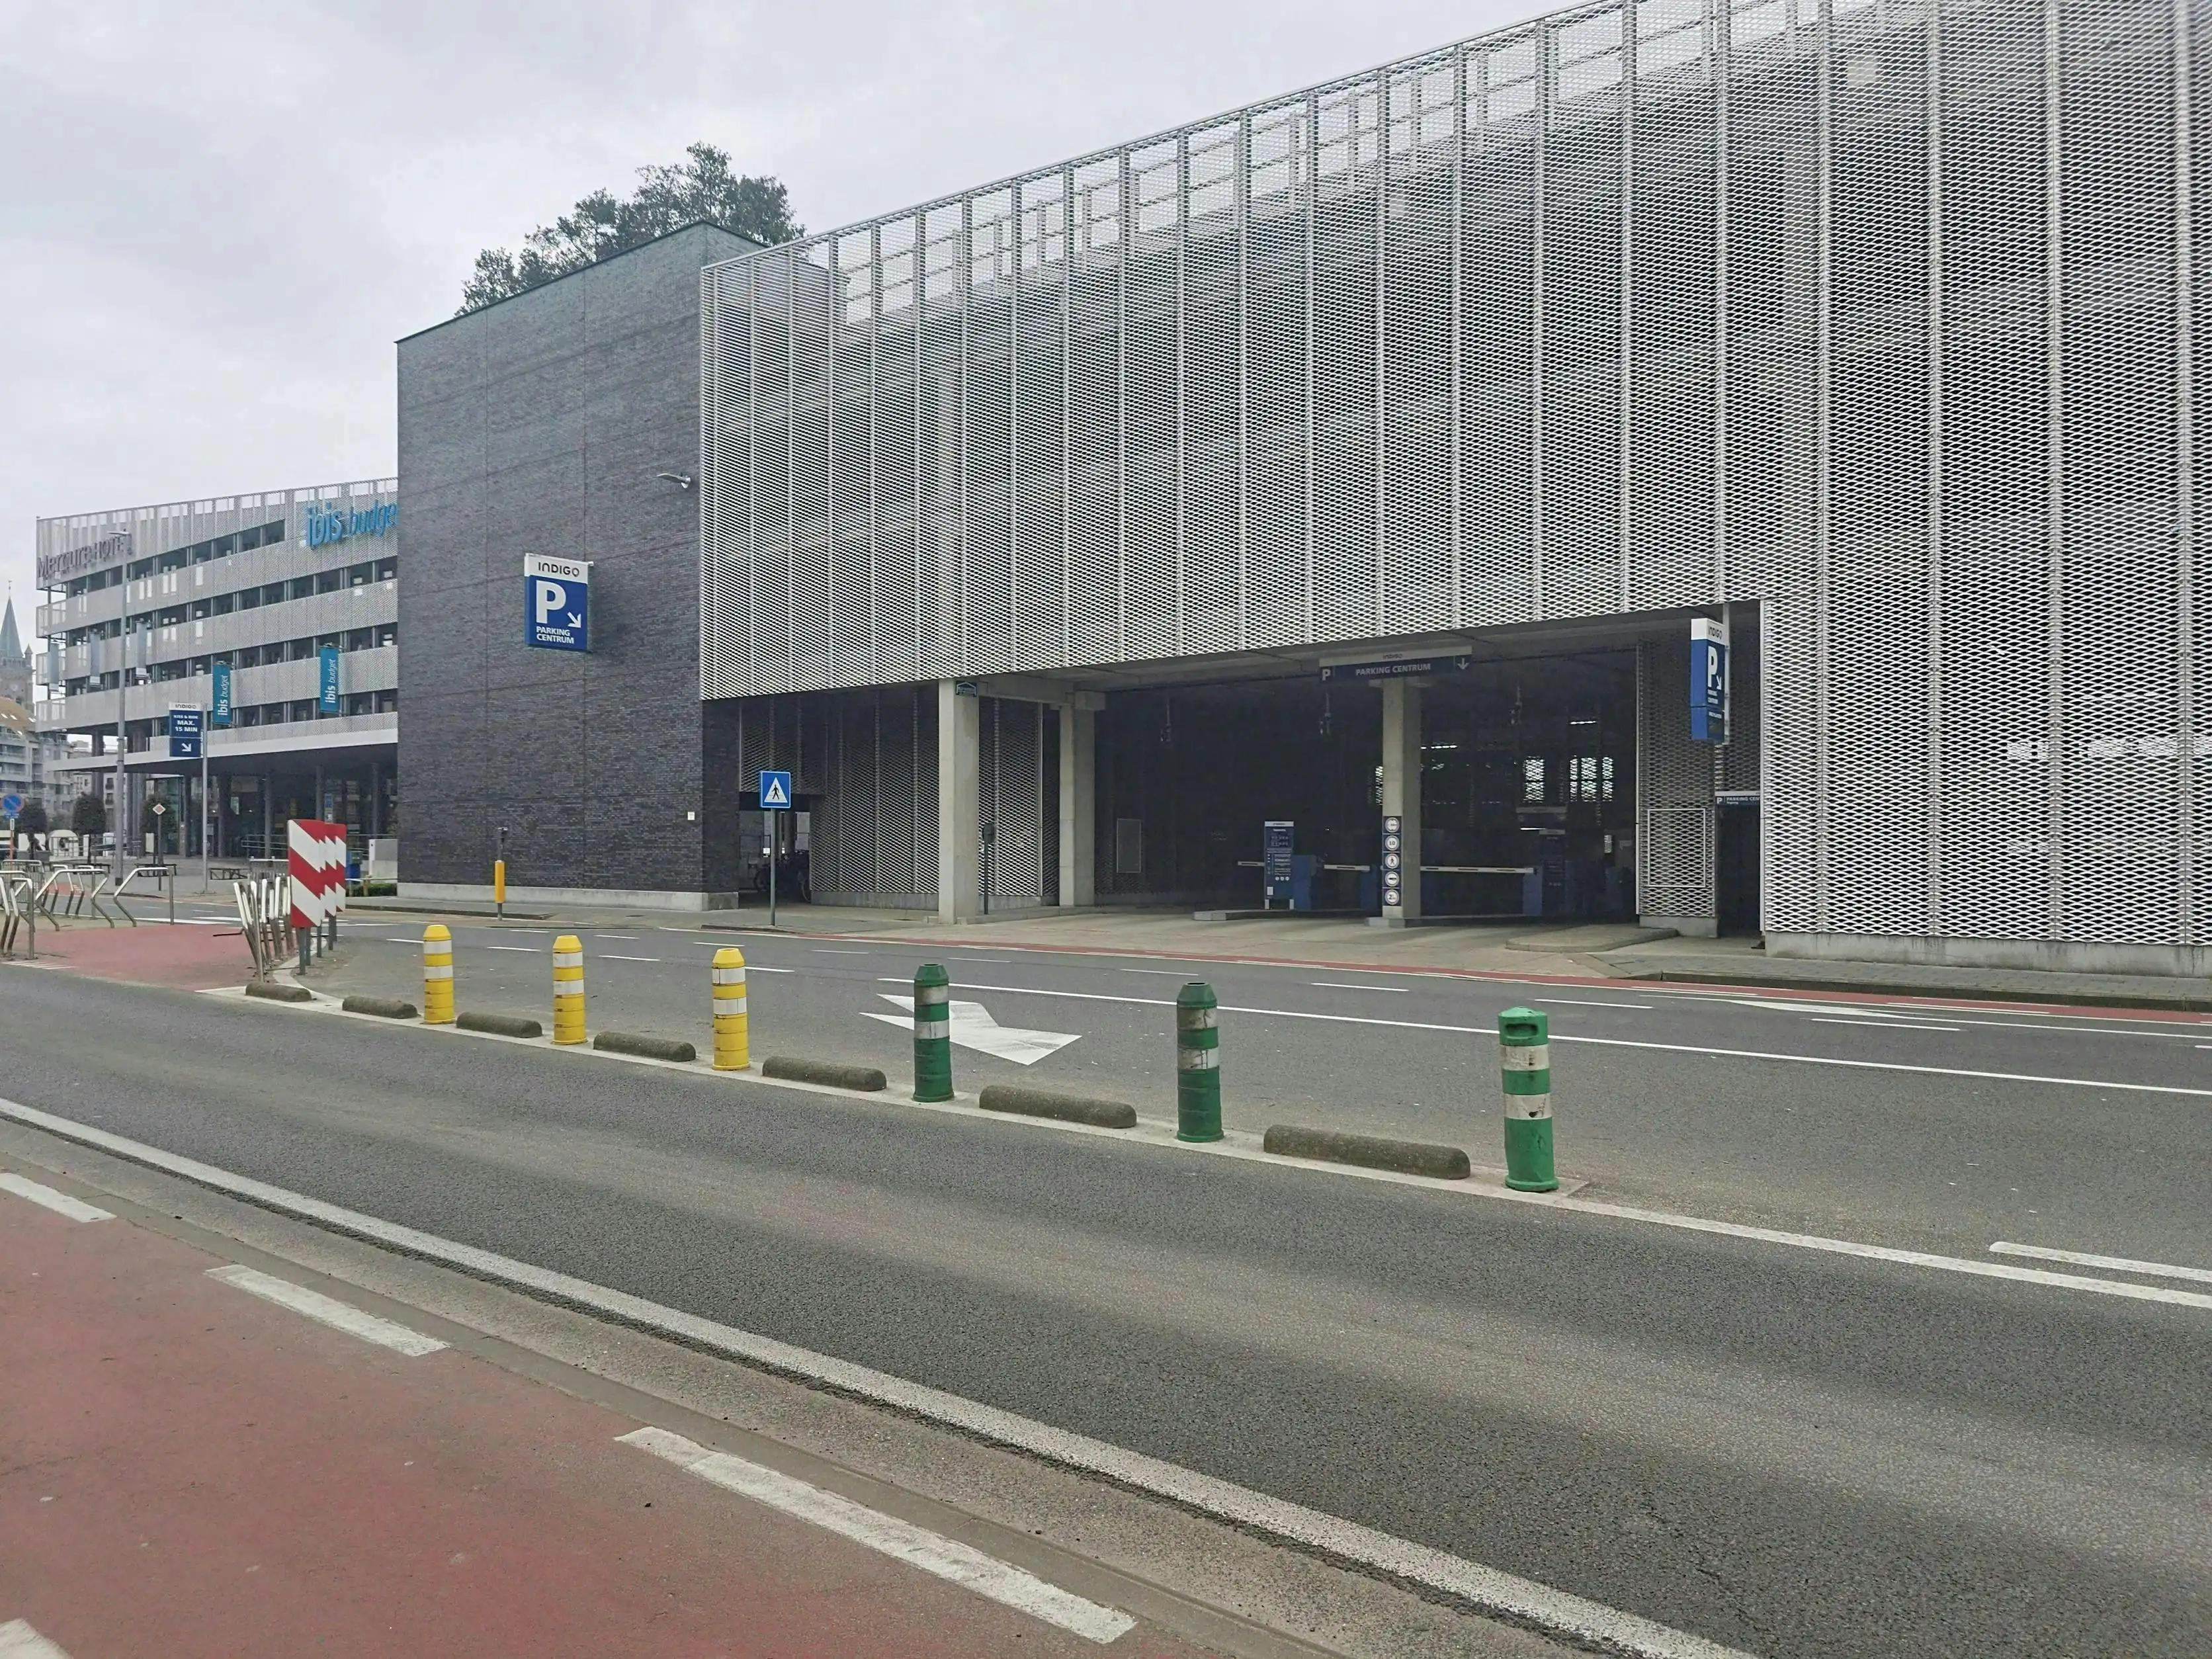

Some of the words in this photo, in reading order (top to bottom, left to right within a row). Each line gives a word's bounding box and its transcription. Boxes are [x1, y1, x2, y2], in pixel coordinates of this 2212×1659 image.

[306, 502, 342, 548] ibis
[538, 562, 579, 577] INDIGO
[536, 579, 566, 624] P
[536, 626, 570, 636] PARKING
[536, 634, 574, 644] CENTRUM
[1707, 626, 1723, 640] INDIGO
[1322, 668, 1331, 681] P
[1355, 666, 1390, 676] PARKING
[1392, 663, 1431, 673] CENTRUM
[1707, 645, 1718, 688] P
[220, 674, 230, 698] budget
[325, 685, 336, 703] ibis
[217, 699, 228, 716] ibis
